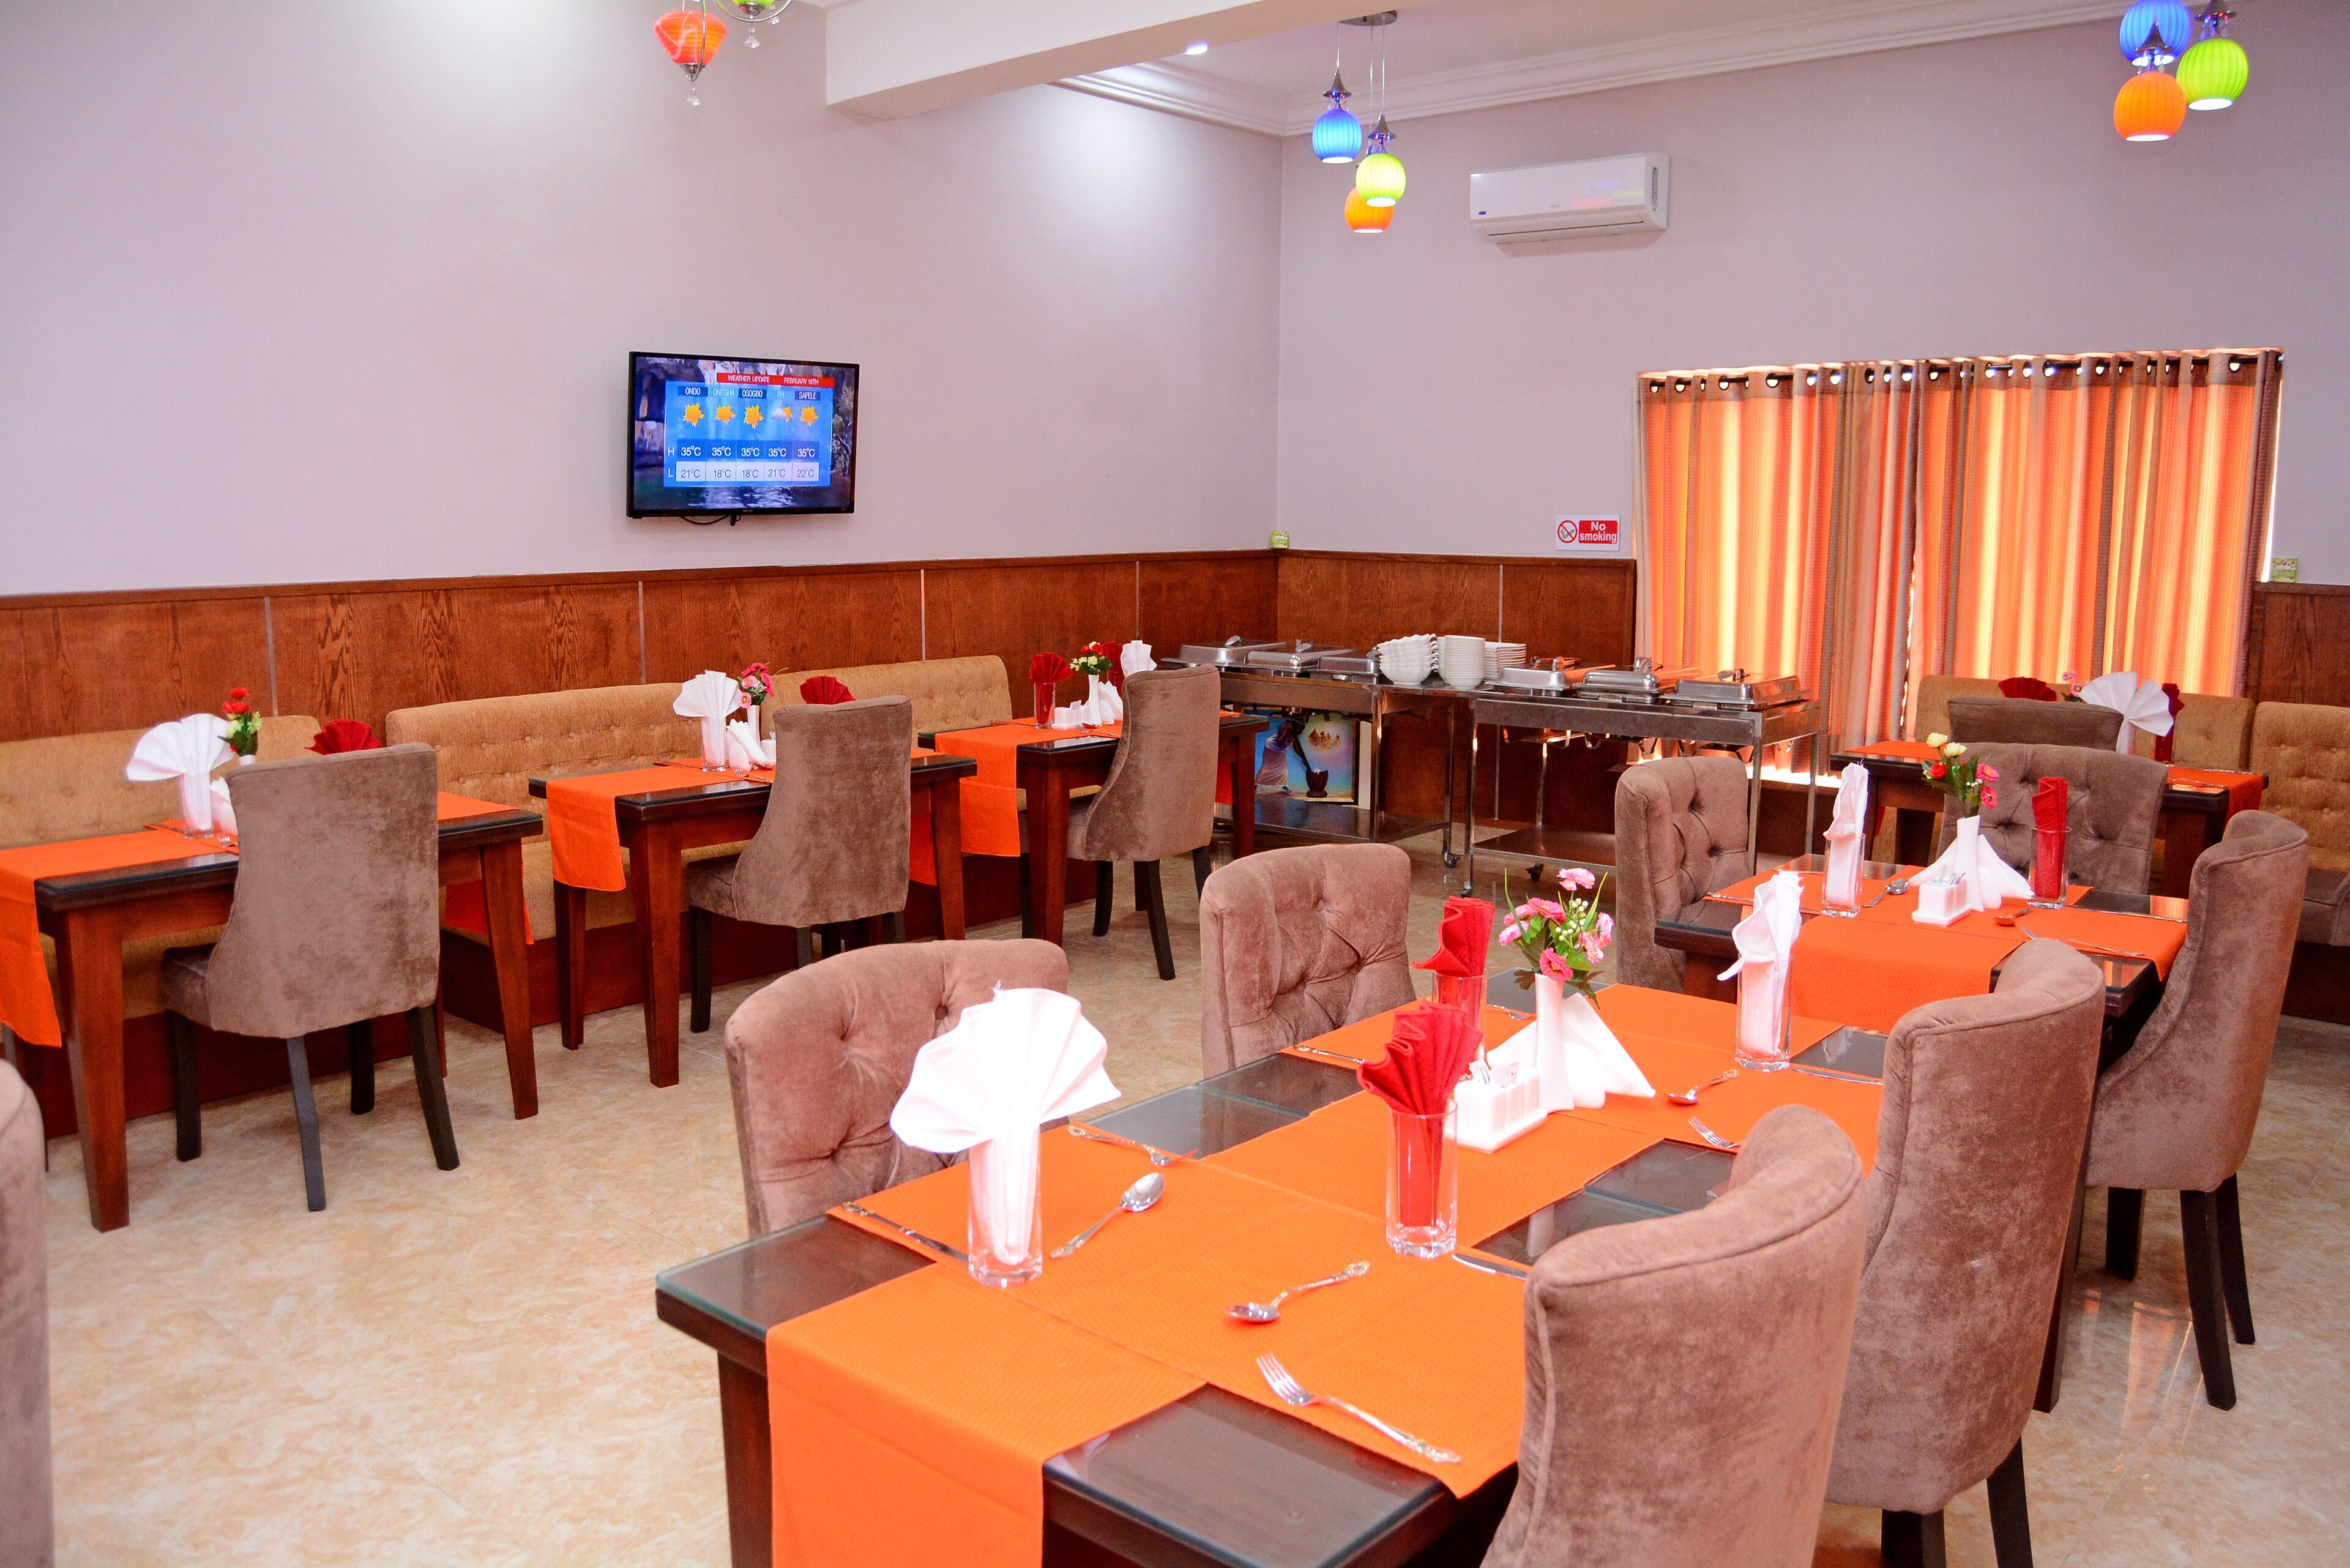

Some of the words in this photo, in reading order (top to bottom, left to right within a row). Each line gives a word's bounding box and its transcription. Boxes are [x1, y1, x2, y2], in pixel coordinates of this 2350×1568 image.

[685, 387, 701, 395] ONDO
[713, 388, 734, 397] ONITSHA
[742, 389, 763, 398] OSOGBO
[799, 391, 816, 400] SAPELE
[668, 447, 674, 456] H
[681, 445, 701, 457] 35°C
[712, 446, 731, 457] 35°C
[741, 447, 760, 457] 35°C
[768, 447, 786, 457] 35°C
[797, 447, 815, 458] 35°C
[668, 468, 674, 477] L
[681, 469, 700, 478] 21°C
[714, 469, 731, 478] 18°C
[1591, 521, 1606, 531] No
[1580, 532, 1617, 543] smoking
